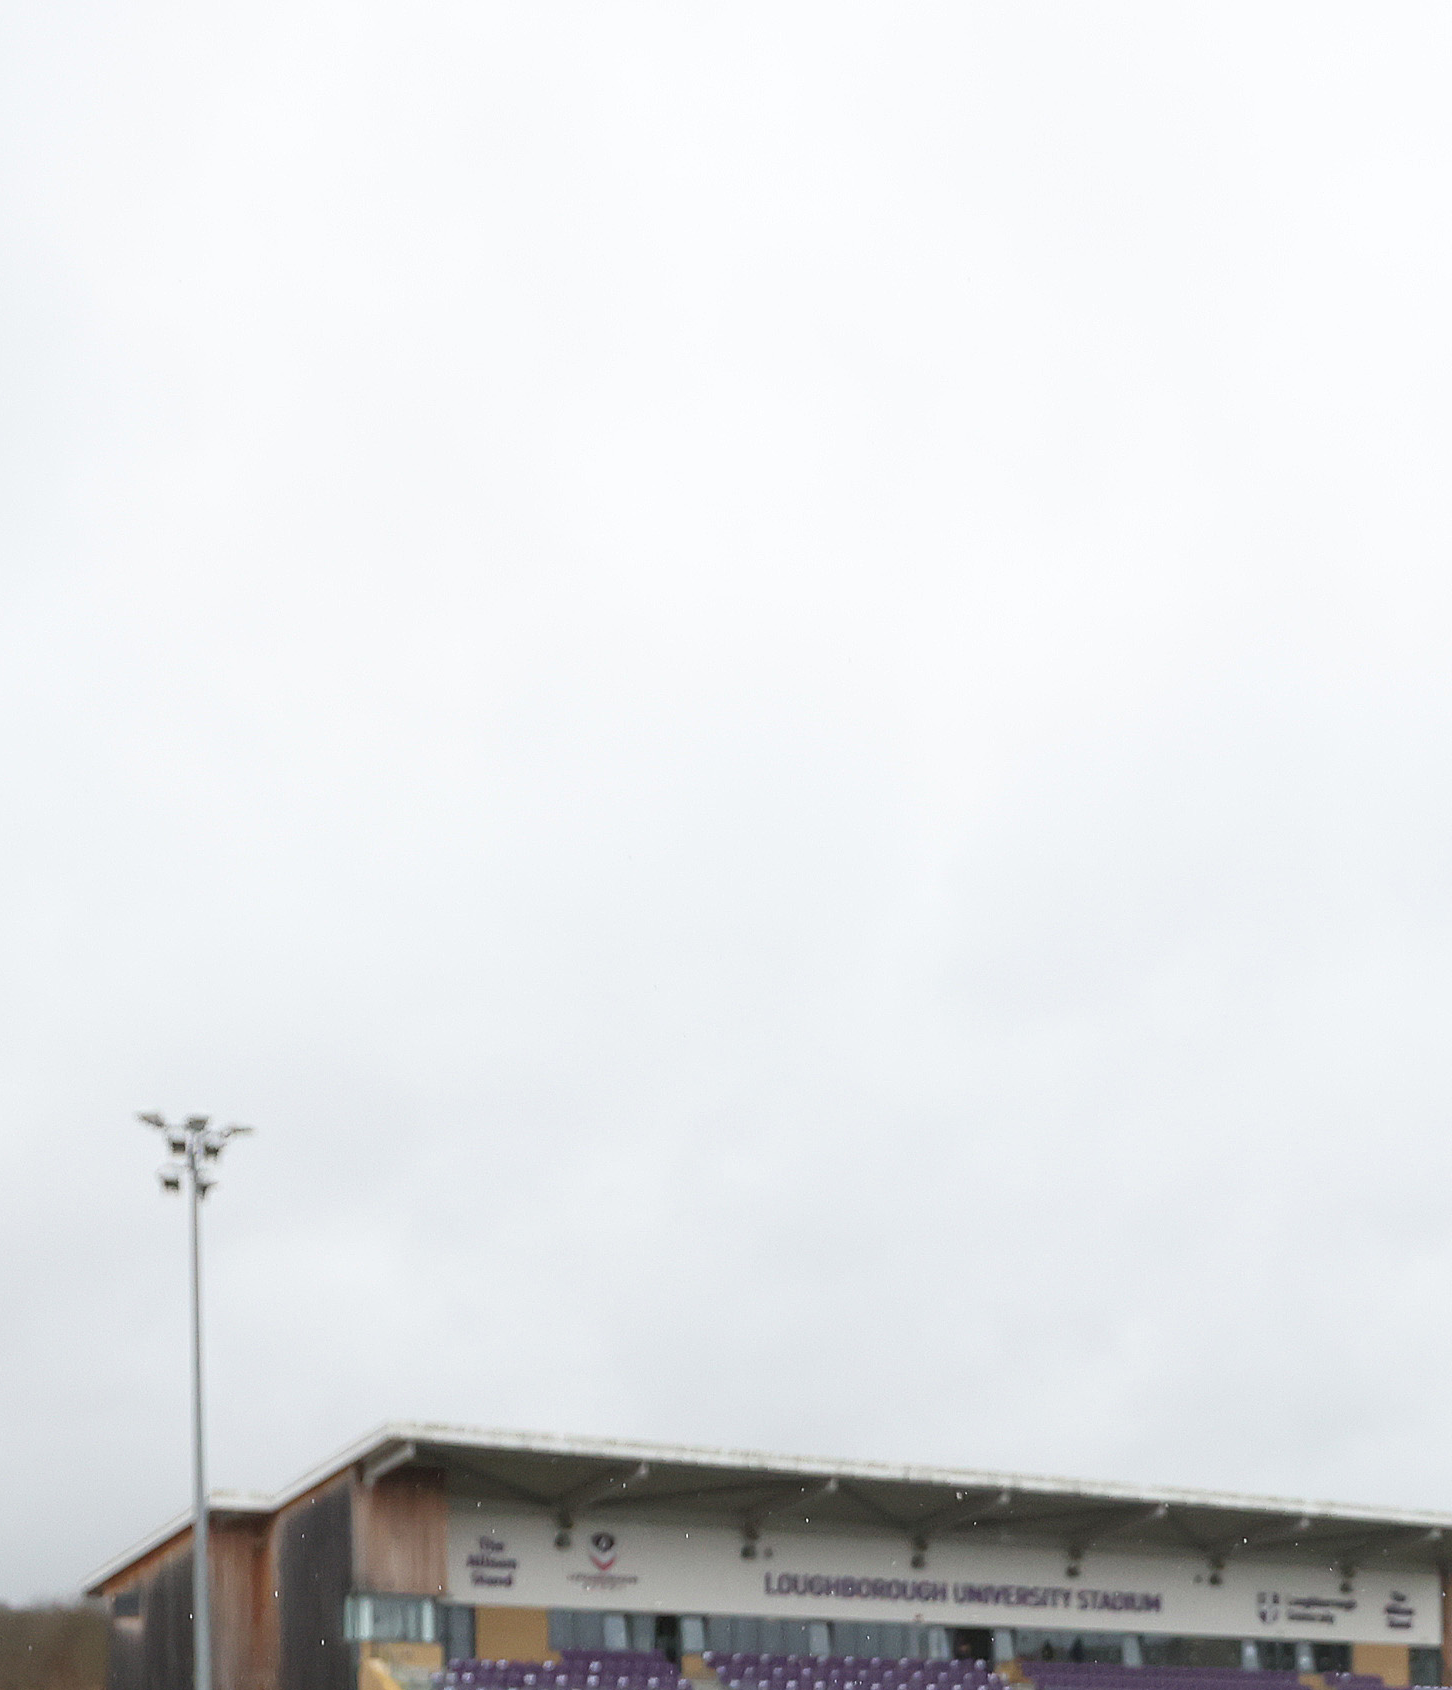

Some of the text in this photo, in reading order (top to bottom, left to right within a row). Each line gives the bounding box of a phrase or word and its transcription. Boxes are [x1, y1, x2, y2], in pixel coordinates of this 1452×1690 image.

[764, 1572, 1162, 1613] LOUGHBOROUGH UNIVERSITY STADIUM
